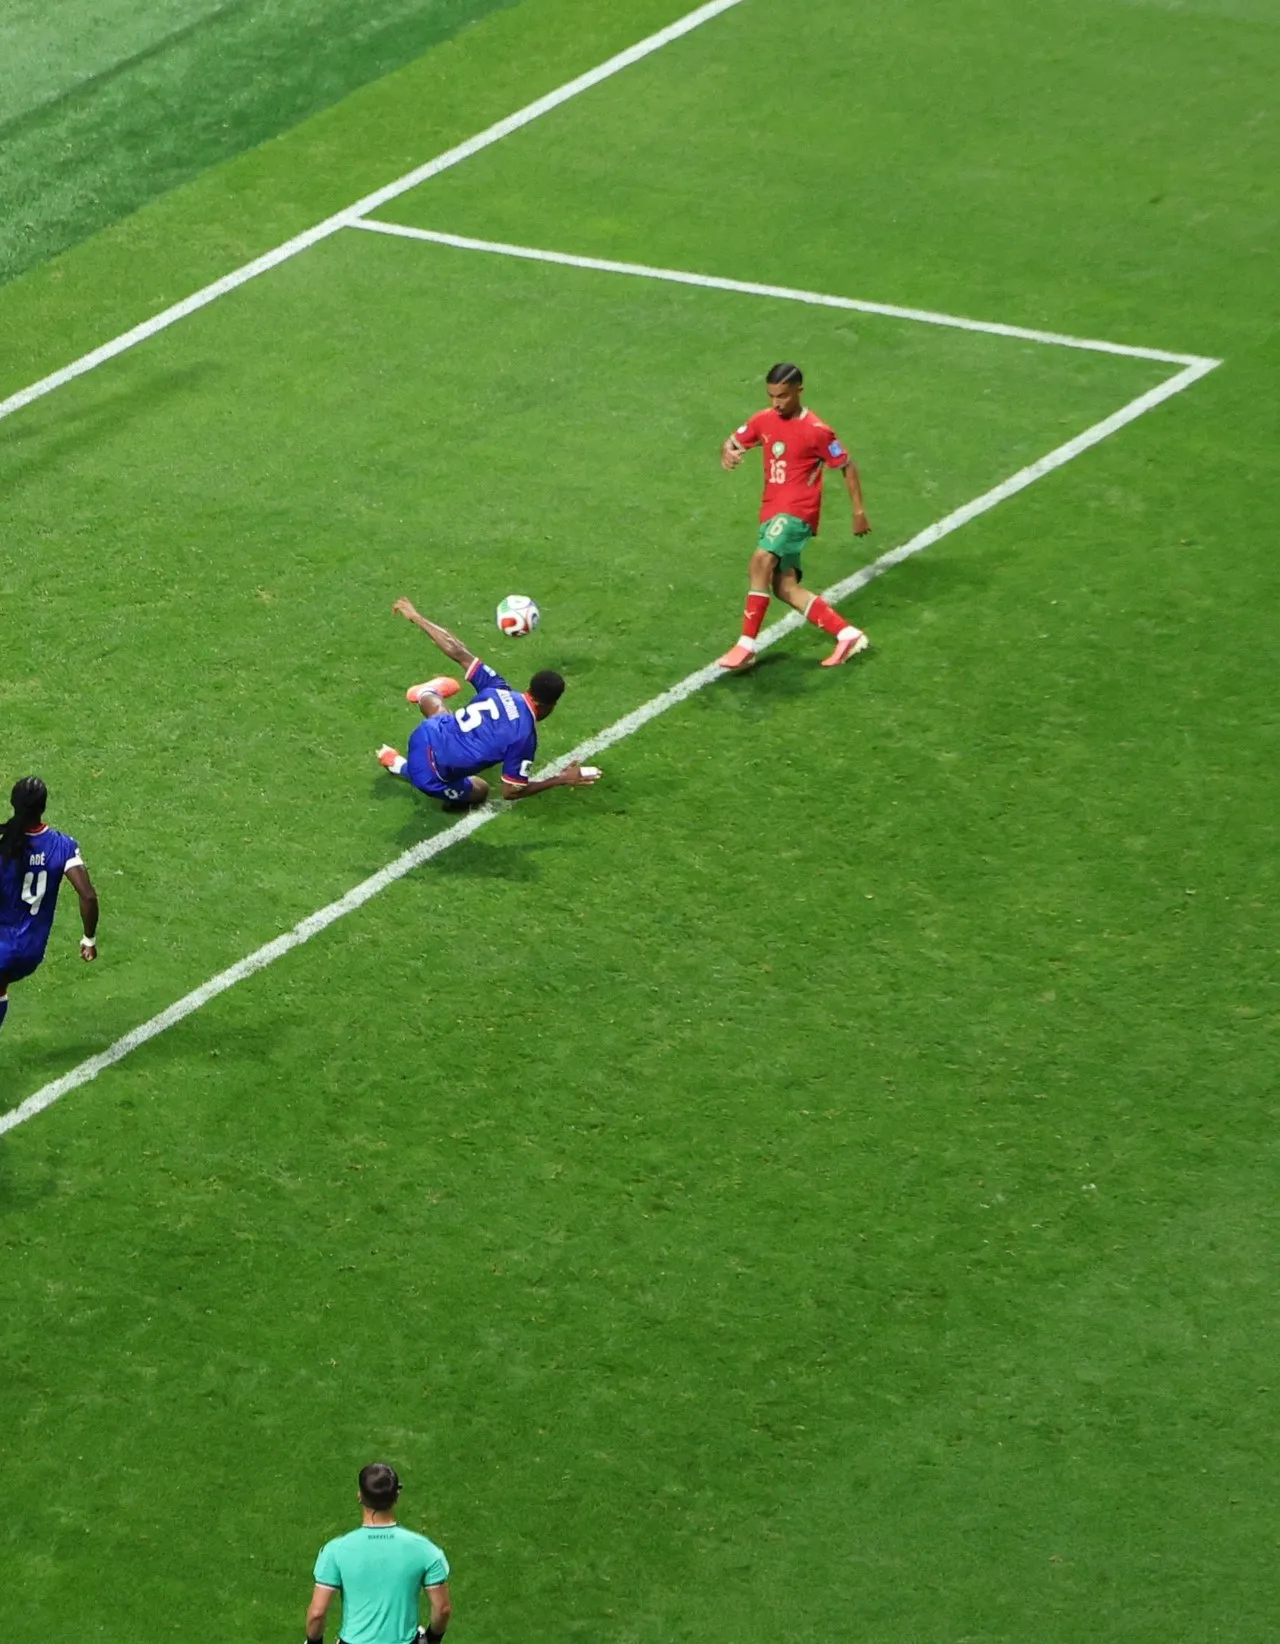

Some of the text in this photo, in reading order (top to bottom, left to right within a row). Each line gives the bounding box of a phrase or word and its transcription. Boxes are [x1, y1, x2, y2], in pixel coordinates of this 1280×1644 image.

[769, 459, 787, 484] 16
[455, 698, 500, 733] 5
[21, 870, 48, 916] 4
